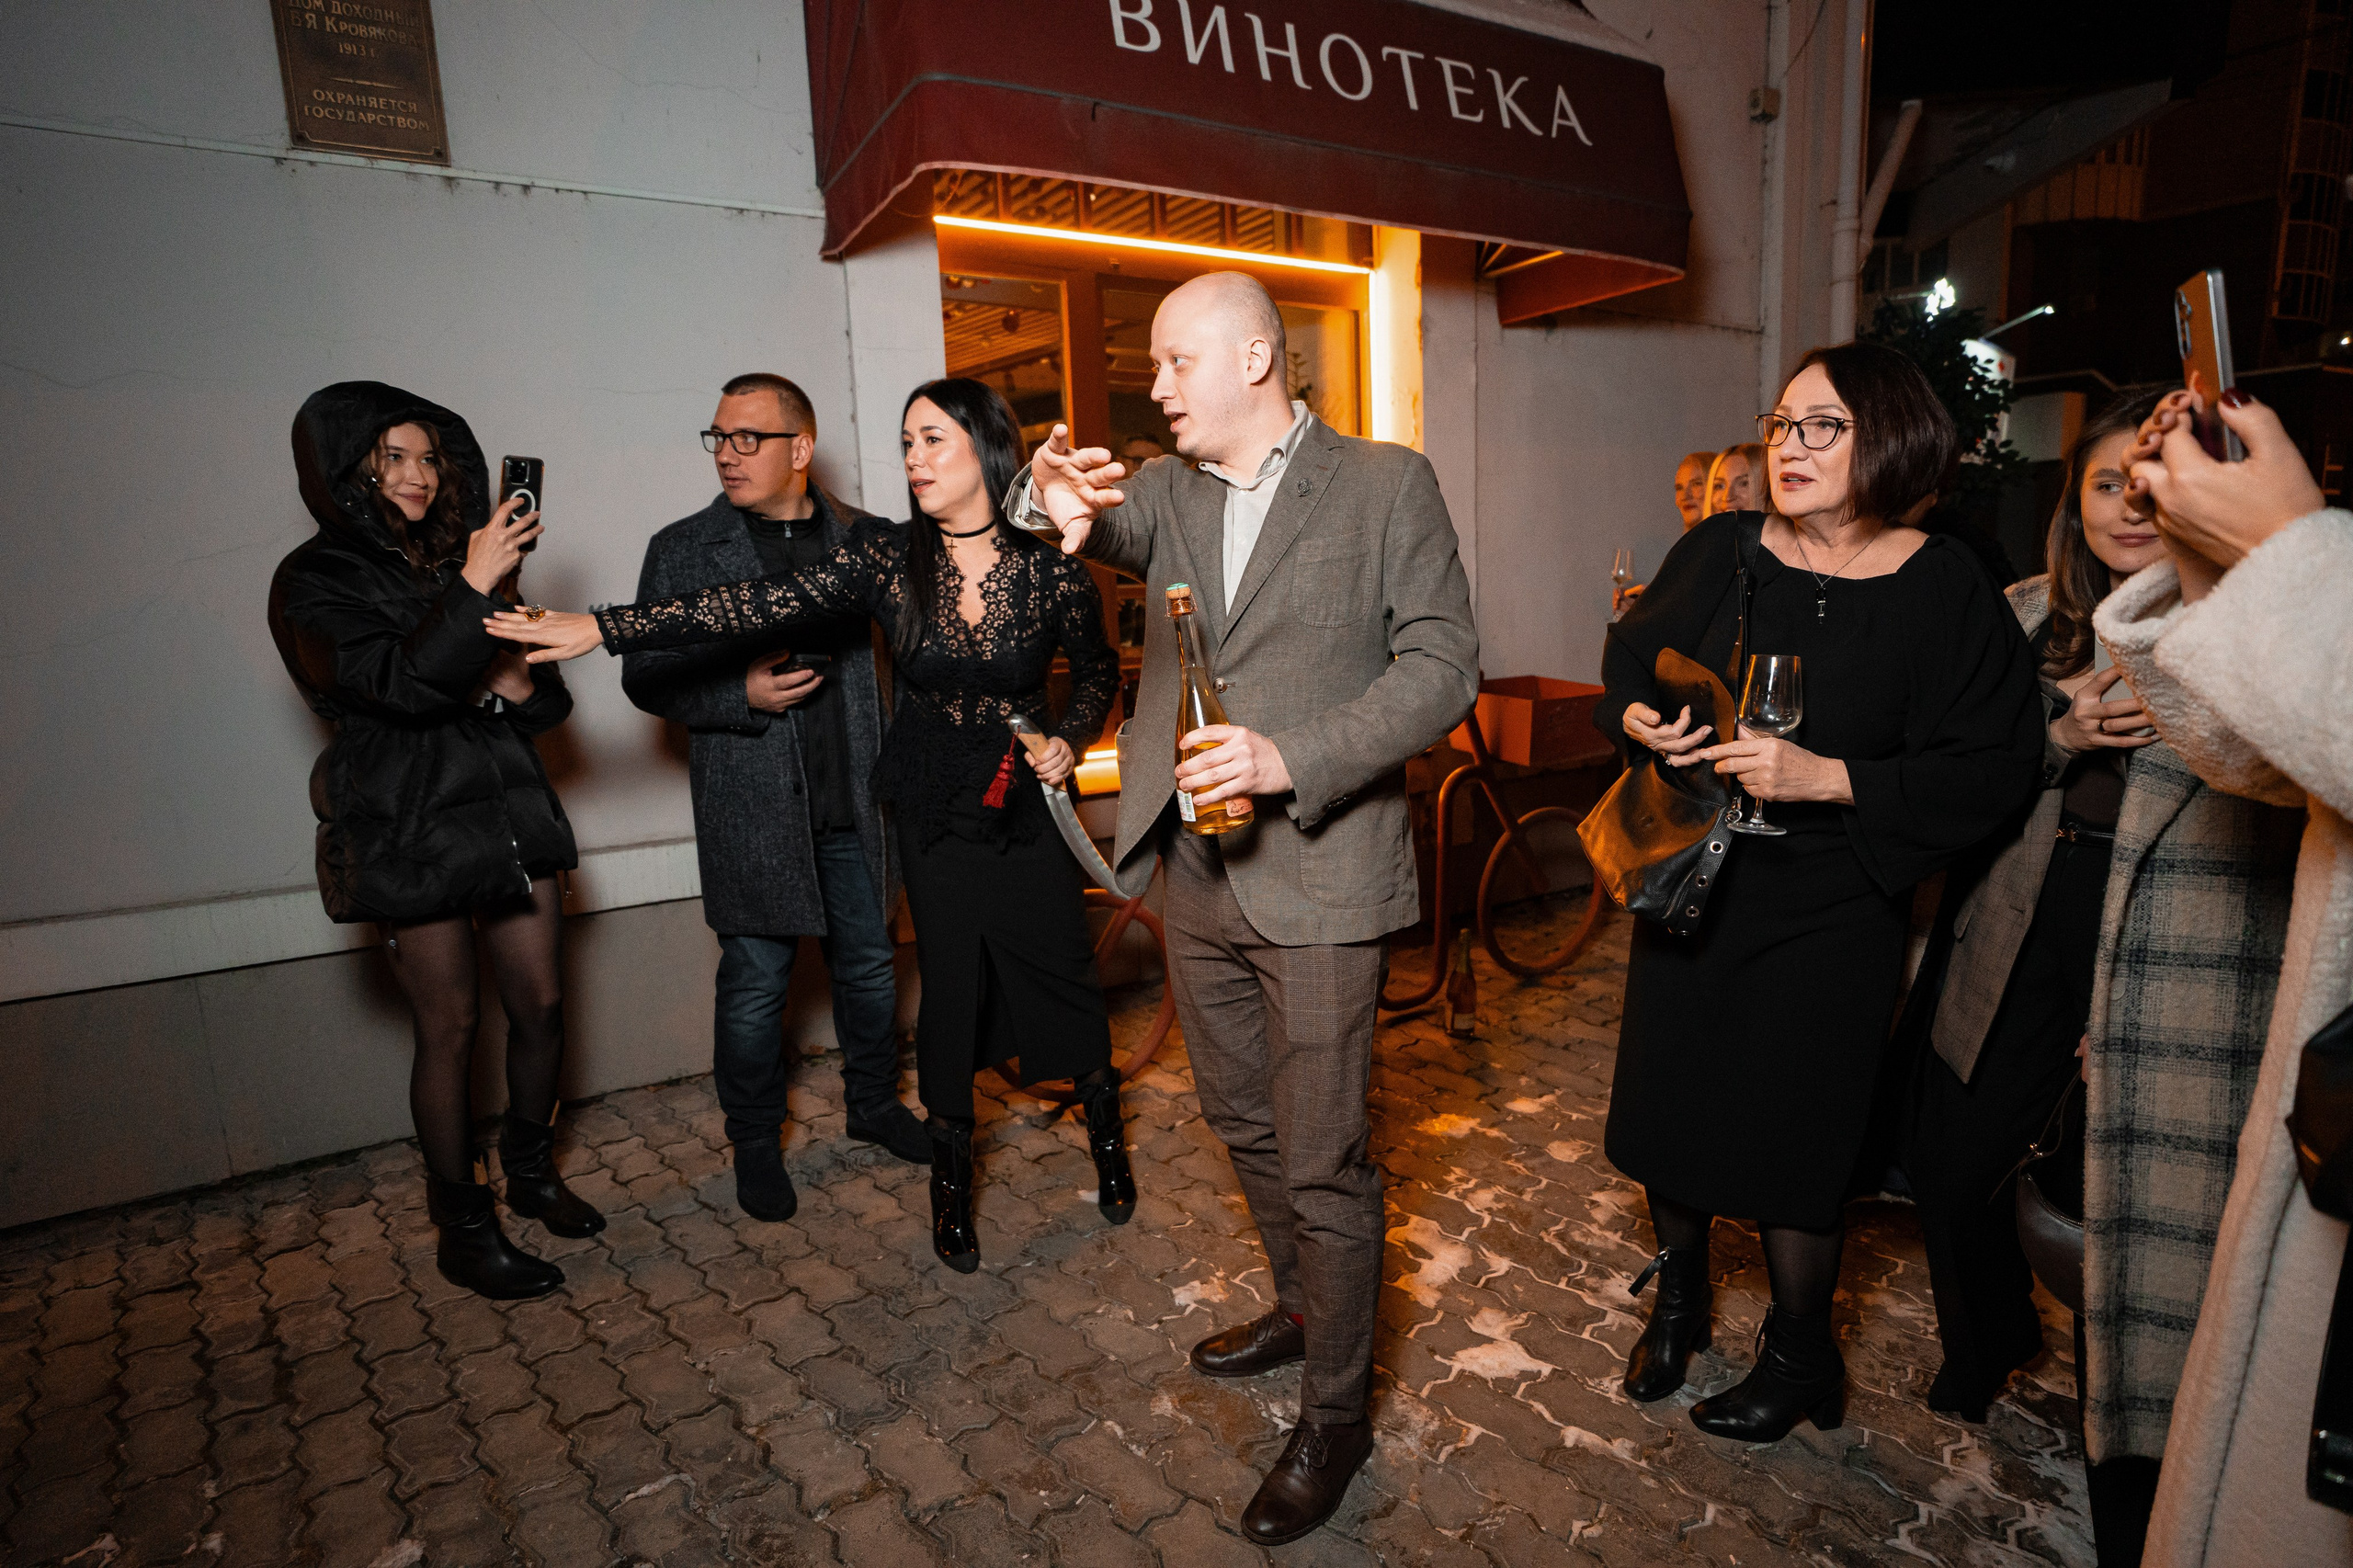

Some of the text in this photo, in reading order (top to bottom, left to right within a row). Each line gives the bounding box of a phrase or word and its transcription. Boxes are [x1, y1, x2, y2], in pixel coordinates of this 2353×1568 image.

[338, 42, 367, 57] 1913
[1110, 0, 1593, 146] ВИНОТЕКА
[313, 89, 418, 114] ОХРАНЯЕТСЯ
[303, 105, 431, 131] ГОСУДАРСТВОМ
